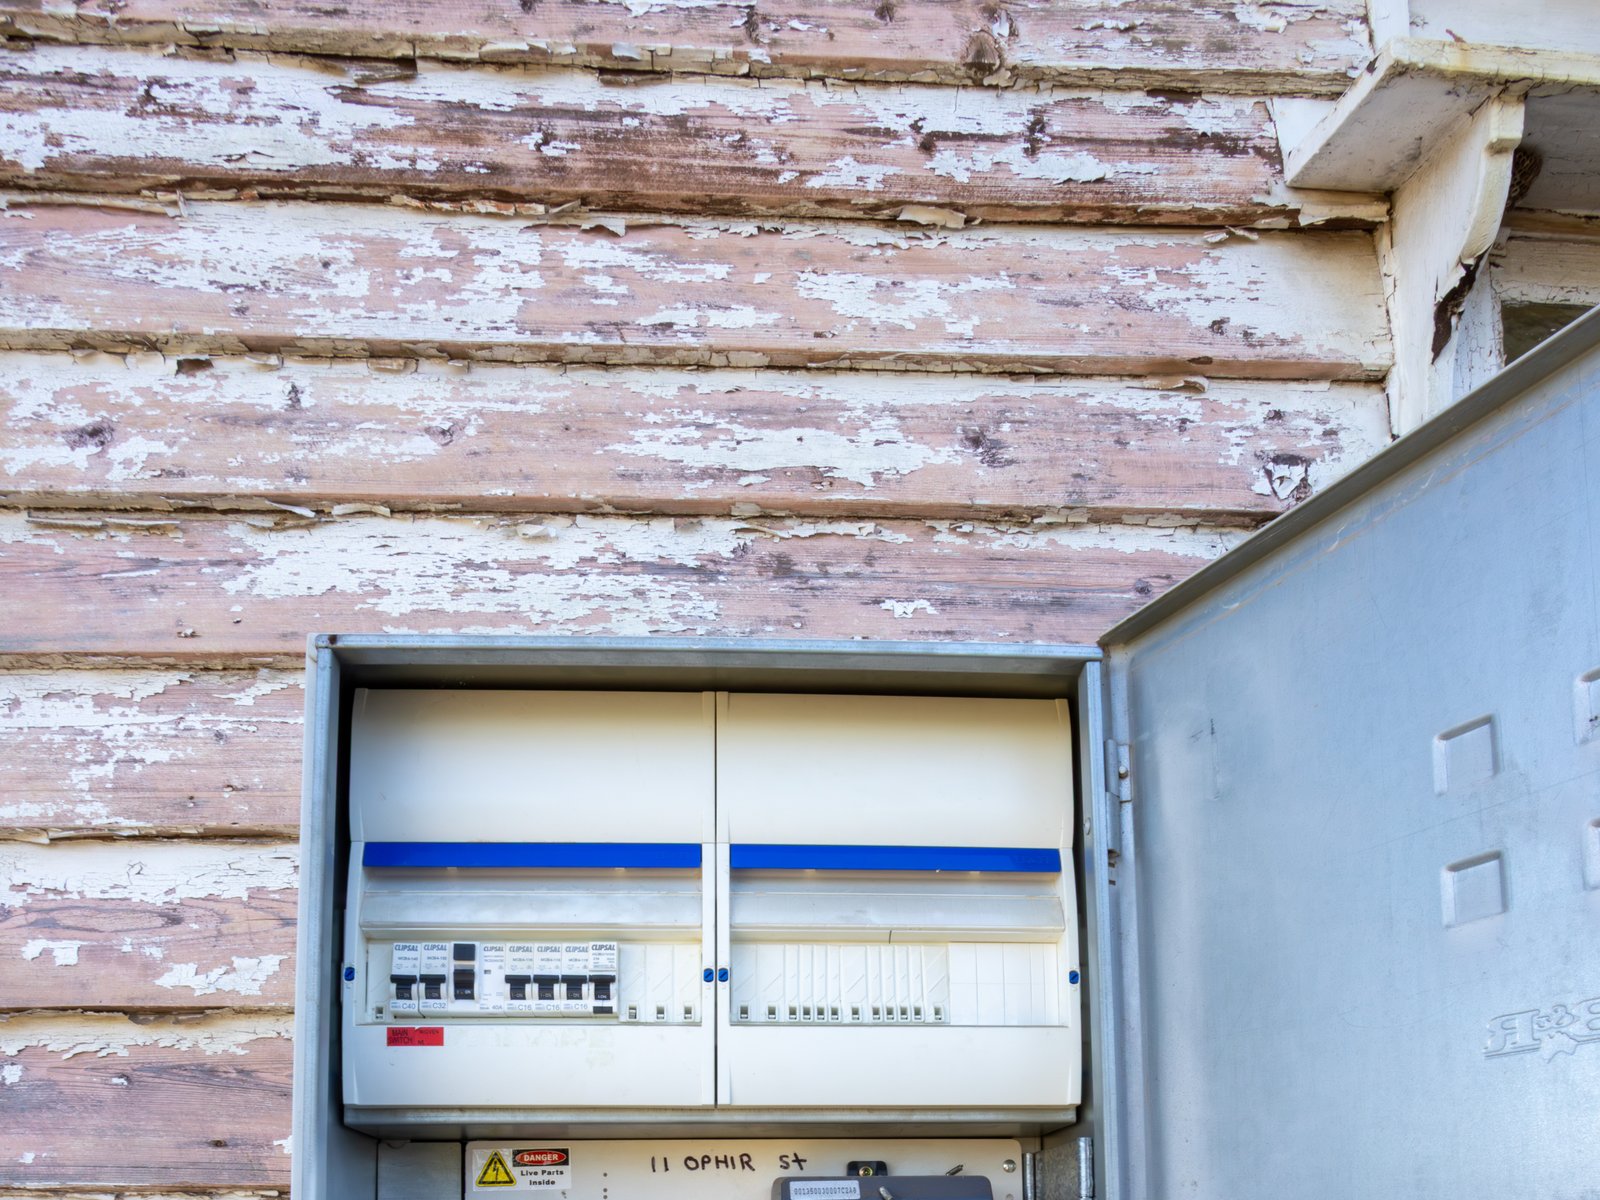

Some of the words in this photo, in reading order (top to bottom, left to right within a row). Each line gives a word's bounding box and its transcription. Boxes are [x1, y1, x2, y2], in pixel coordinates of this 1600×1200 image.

[394, 944, 418, 952] CLIPSAL
[423, 943, 447, 951] CLIPSAL
[508, 945, 533, 953] CLIPSAL
[536, 945, 561, 953] CLIPSAL
[564, 945, 589, 953] CLIPSAL
[401, 1002, 416, 1010] C40
[523, 1153, 559, 1162] DANGER
[651, 1156, 670, 1173] 11
[684, 1153, 755, 1172] OPHIR
[520, 1169, 539, 1177] Live
